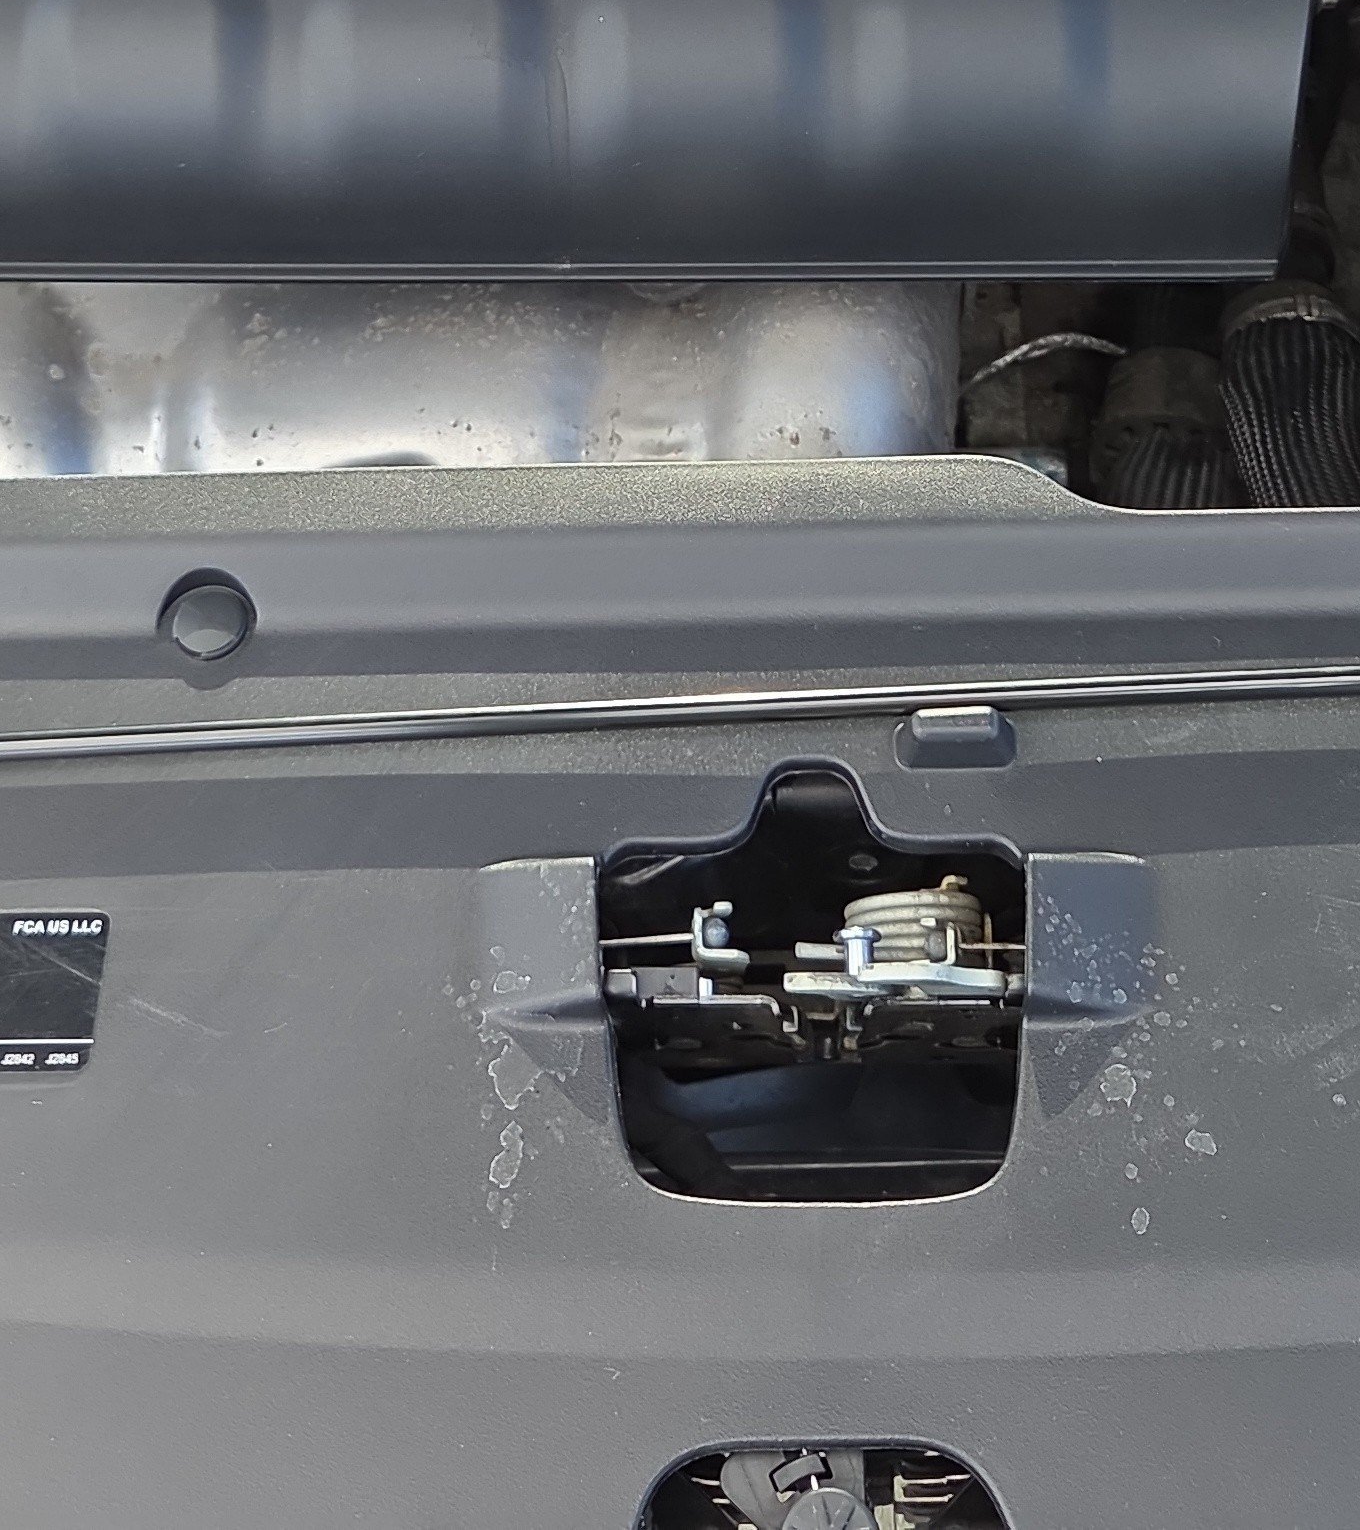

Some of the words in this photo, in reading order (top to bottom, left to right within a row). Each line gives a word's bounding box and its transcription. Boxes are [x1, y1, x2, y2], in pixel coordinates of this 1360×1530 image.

[12, 919, 46, 936] FCA
[46, 919, 70, 936] US
[71, 919, 103, 936] LLC
